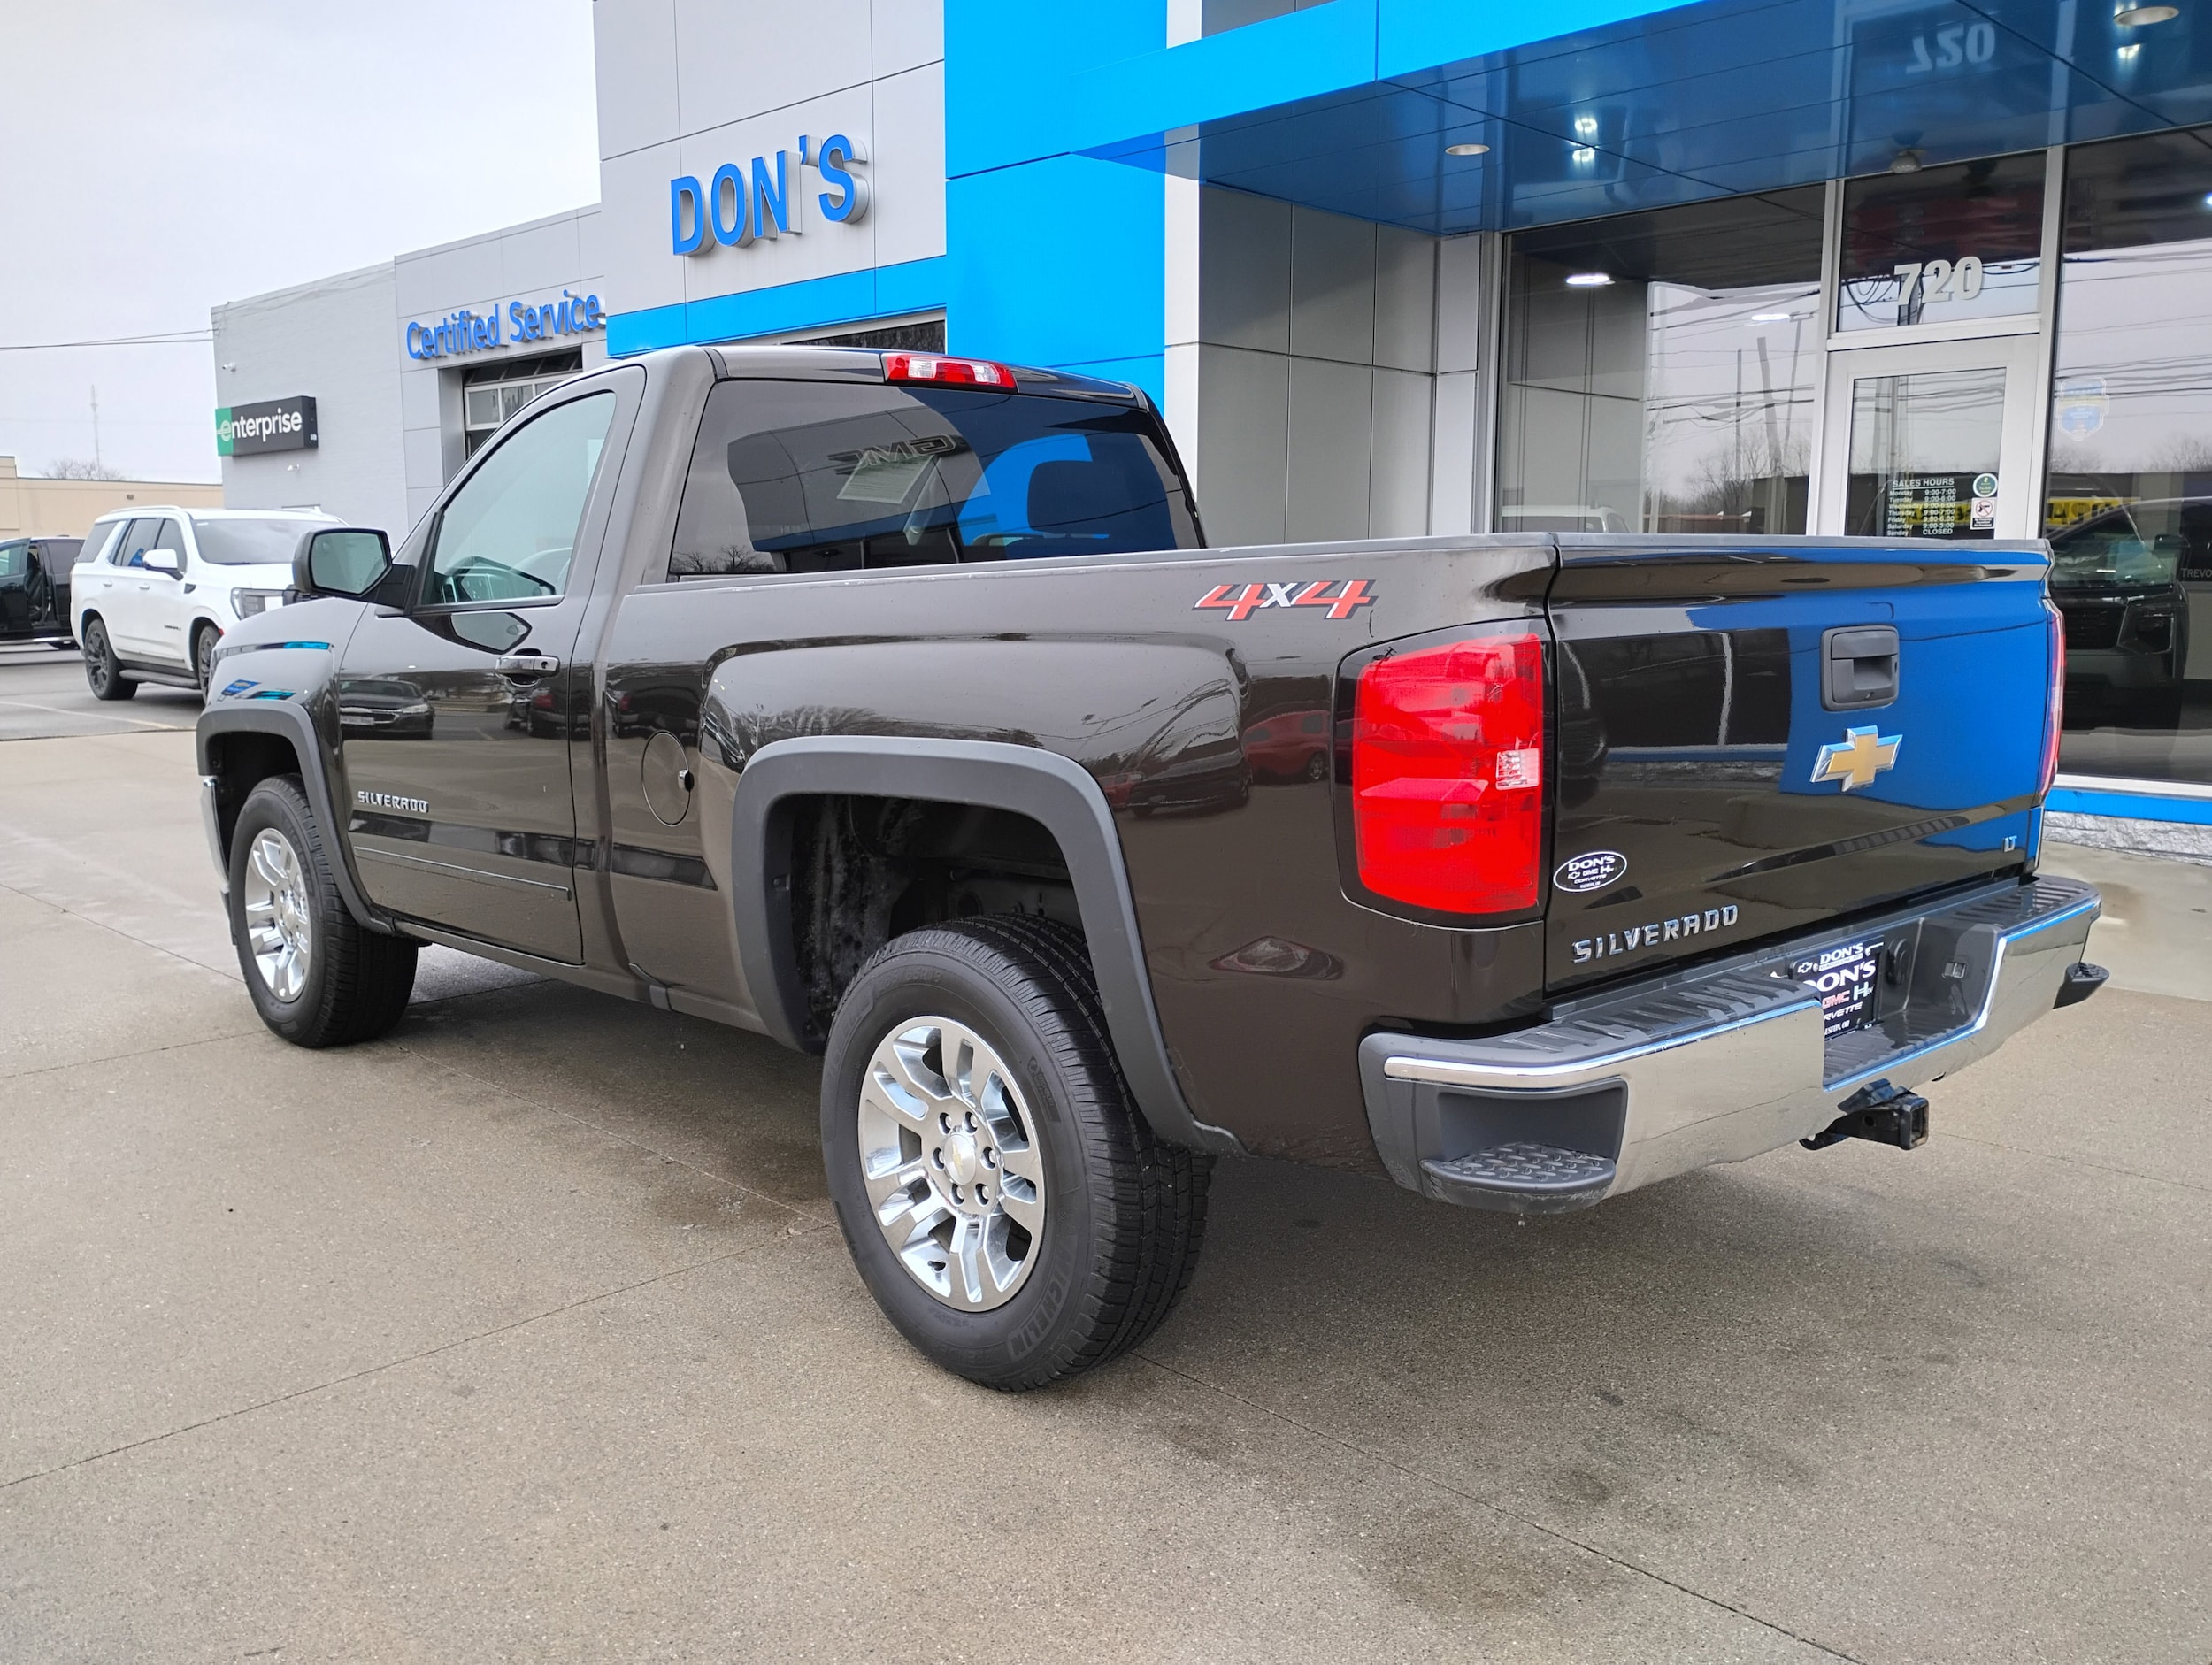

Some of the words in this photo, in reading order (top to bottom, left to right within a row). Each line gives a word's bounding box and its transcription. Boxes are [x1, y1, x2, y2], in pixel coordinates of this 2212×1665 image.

[670, 134, 861, 256] DON'S
[1894, 256, 1983, 306] 720
[406, 303, 501, 360] Certified
[508, 289, 601, 342] Service
[218, 407, 303, 442] enterprise
[1893, 479, 1921, 487] SALES
[1923, 478, 1955, 487] HOURS
[357, 790, 429, 814] SILVERADO
[2003, 835, 2017, 853] LT
[1568, 856, 1616, 871] DON'S
[1571, 904, 1739, 964] SILVERADO
[1819, 942, 1863, 965] DON'S
[1822, 990, 1850, 1009] GMC
[1824, 1001, 1863, 1021] RVETTE
